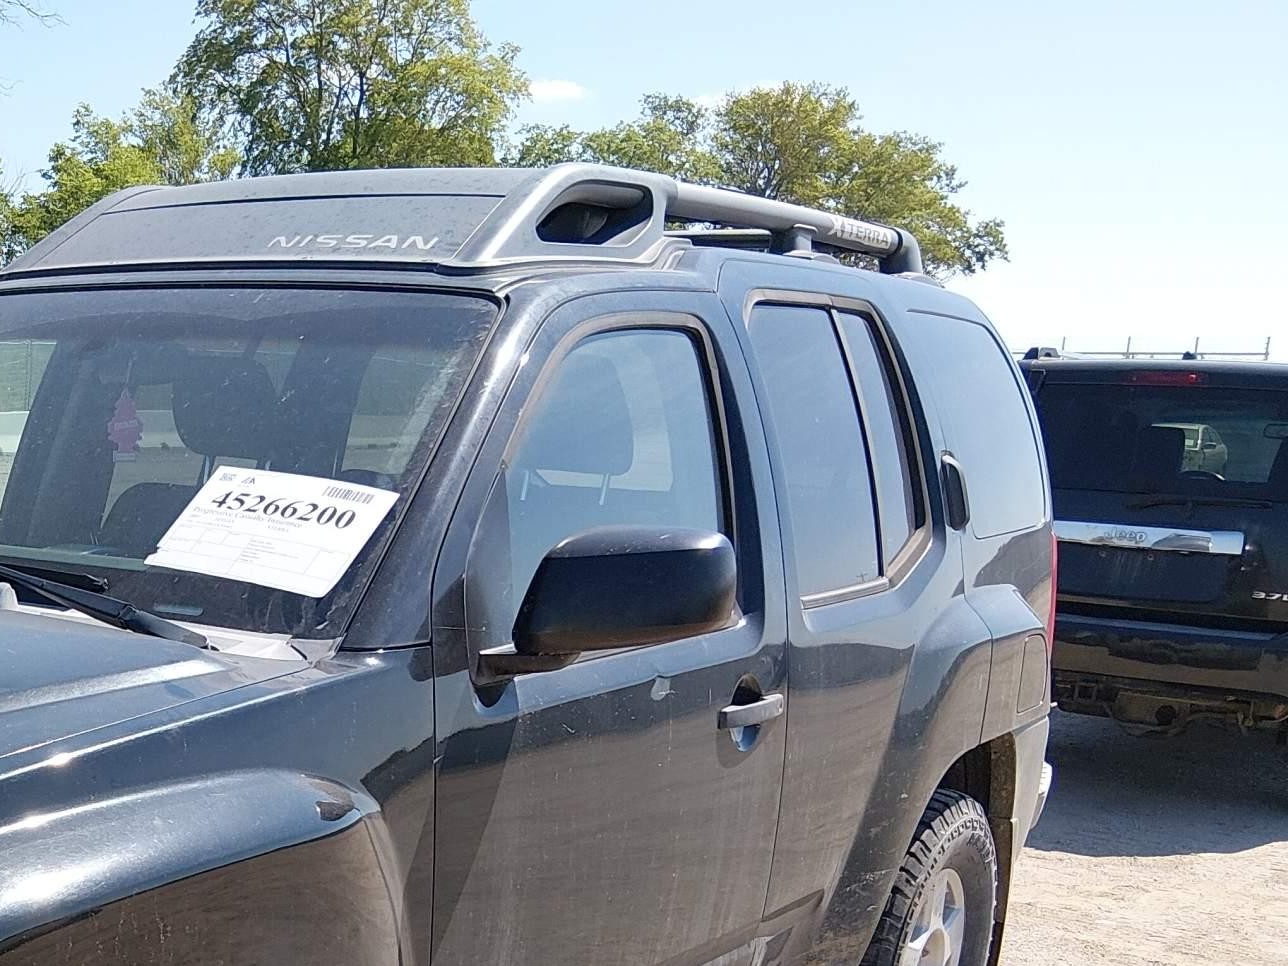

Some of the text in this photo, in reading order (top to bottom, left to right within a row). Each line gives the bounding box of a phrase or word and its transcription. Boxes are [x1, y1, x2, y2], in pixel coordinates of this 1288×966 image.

[267, 235, 439, 249] NISSAN
[211, 490, 357, 529] 45266200
[1103, 526, 1148, 545] Jeep
